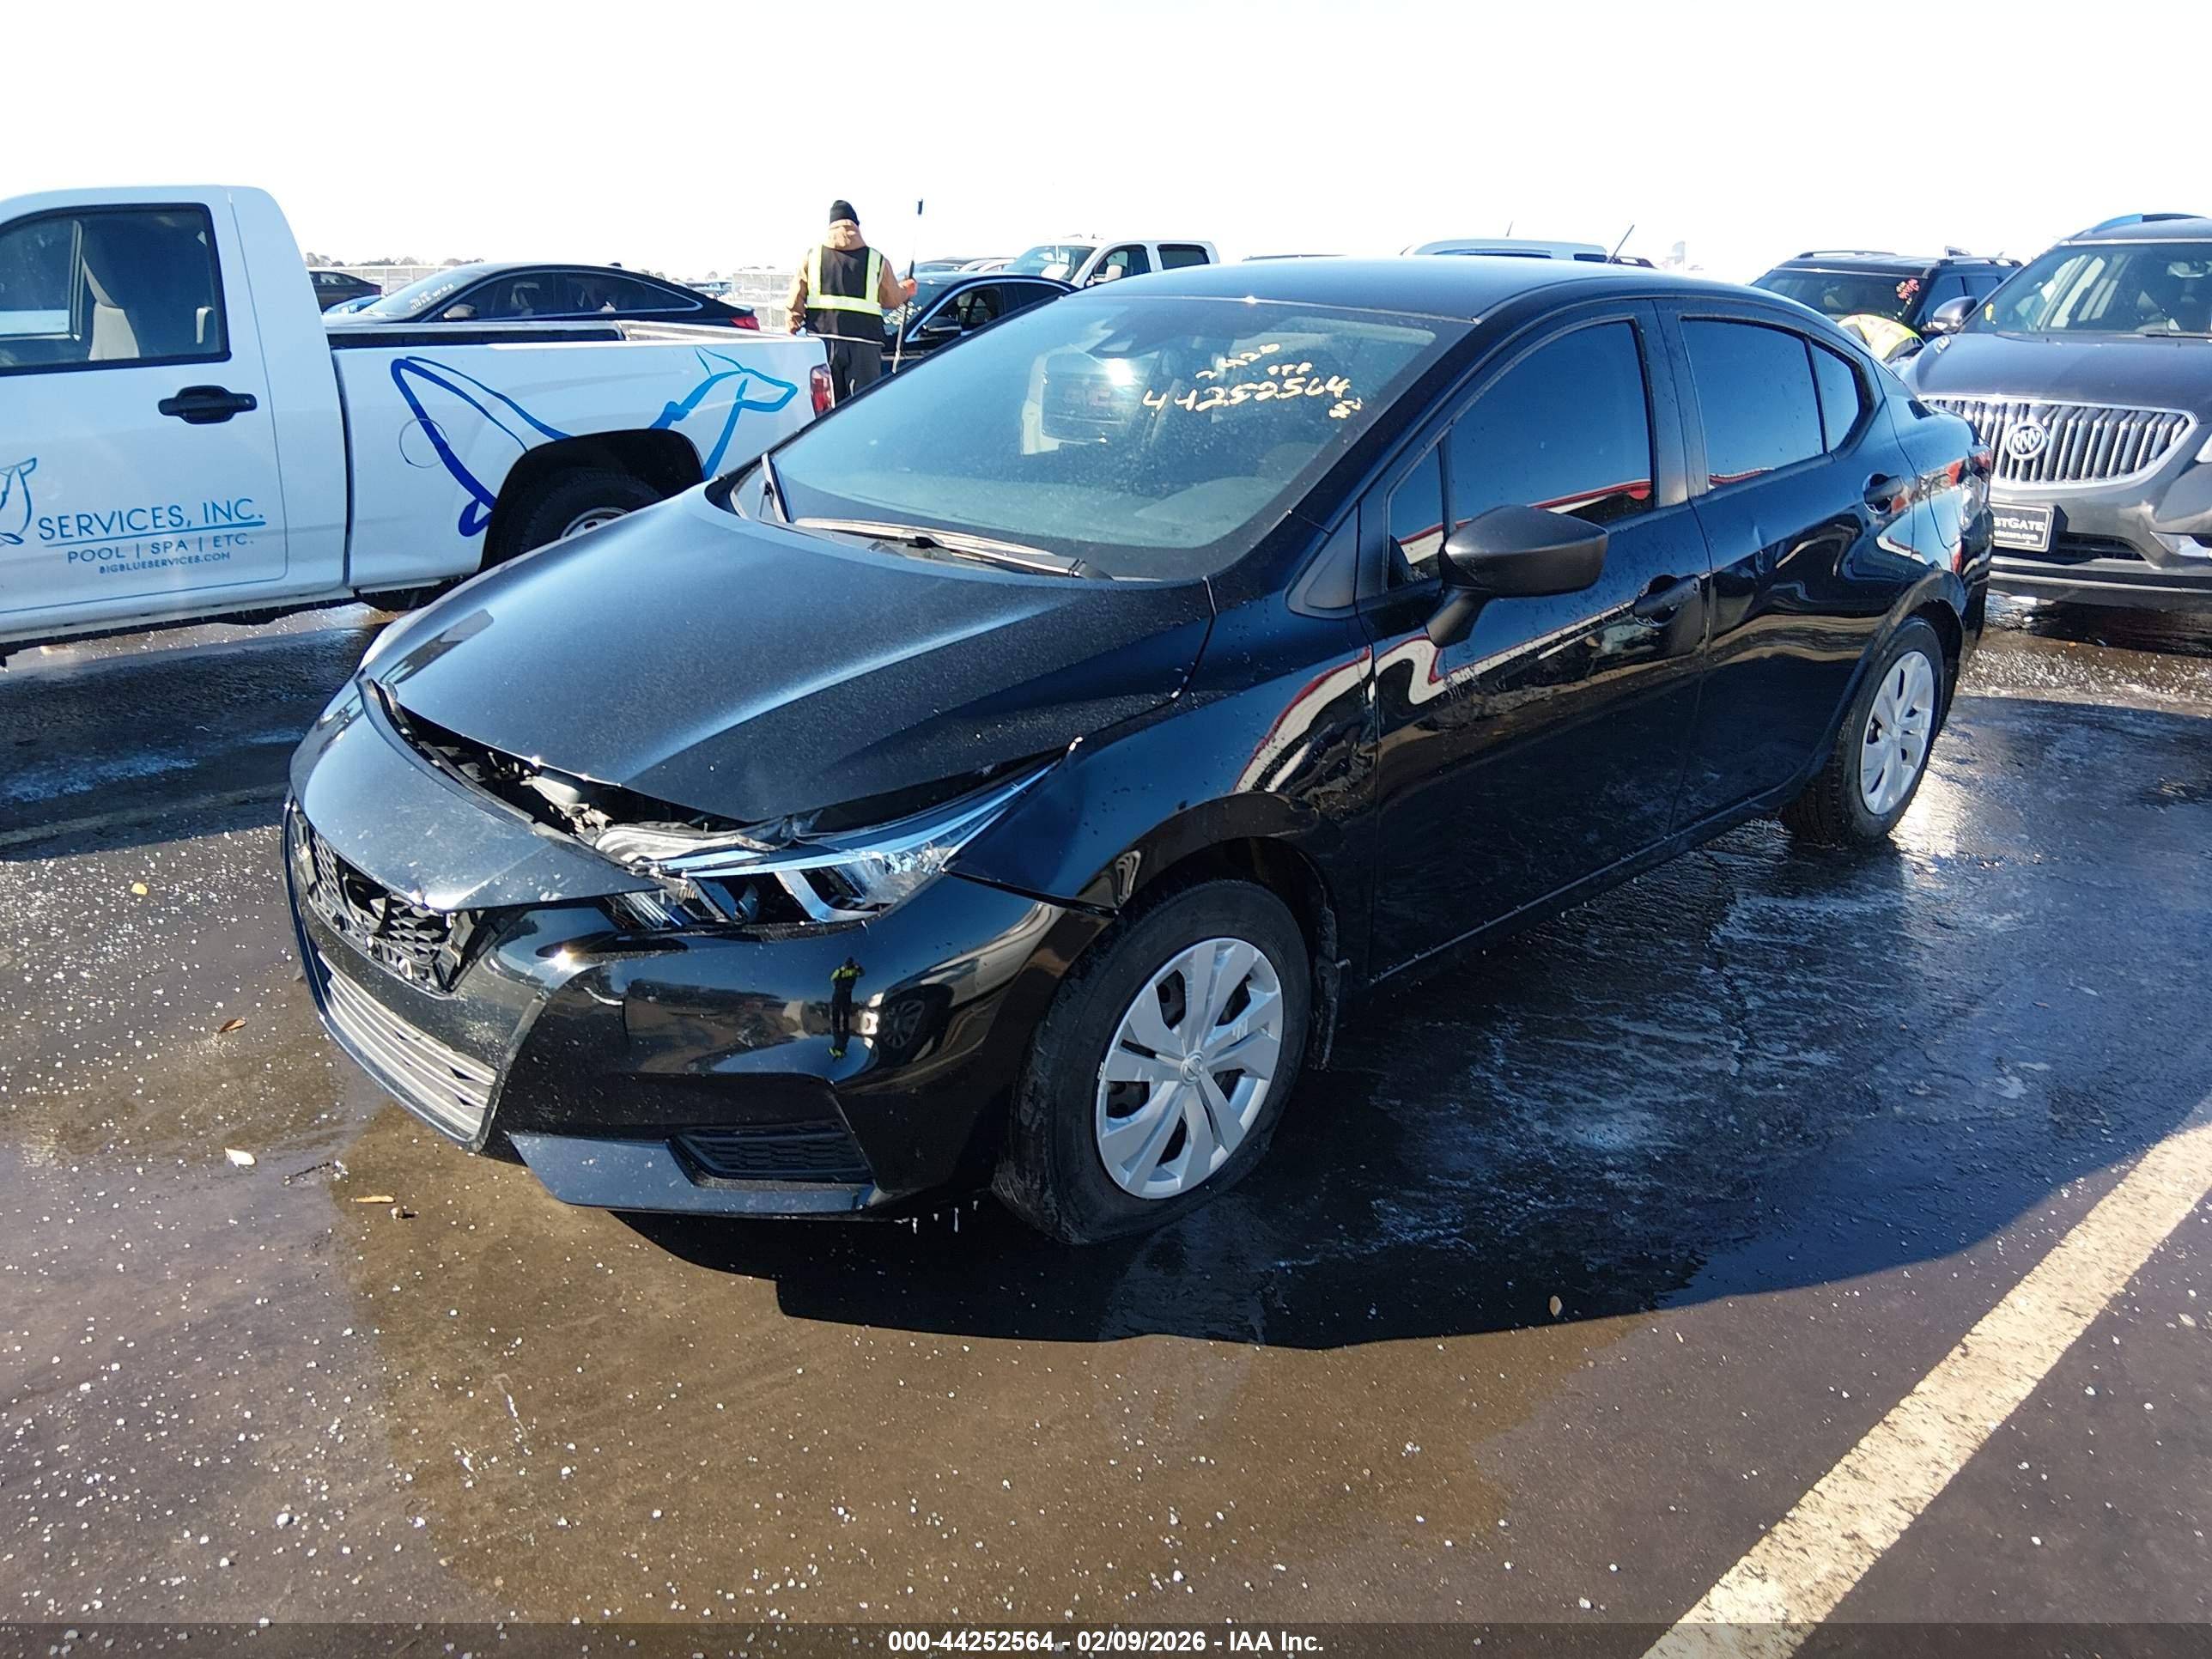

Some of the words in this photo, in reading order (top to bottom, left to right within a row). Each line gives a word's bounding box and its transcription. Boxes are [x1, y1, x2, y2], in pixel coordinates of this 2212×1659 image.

[38, 504, 191, 541] SERVICES,
[203, 498, 263, 524] INC.
[1993, 517, 2045, 532] STGATE
[68, 546, 126, 564] POOL
[150, 538, 189, 555] SPA
[213, 532, 254, 549] ETC.
[99, 551, 231, 574] BIGBLUESERVICES.COM
